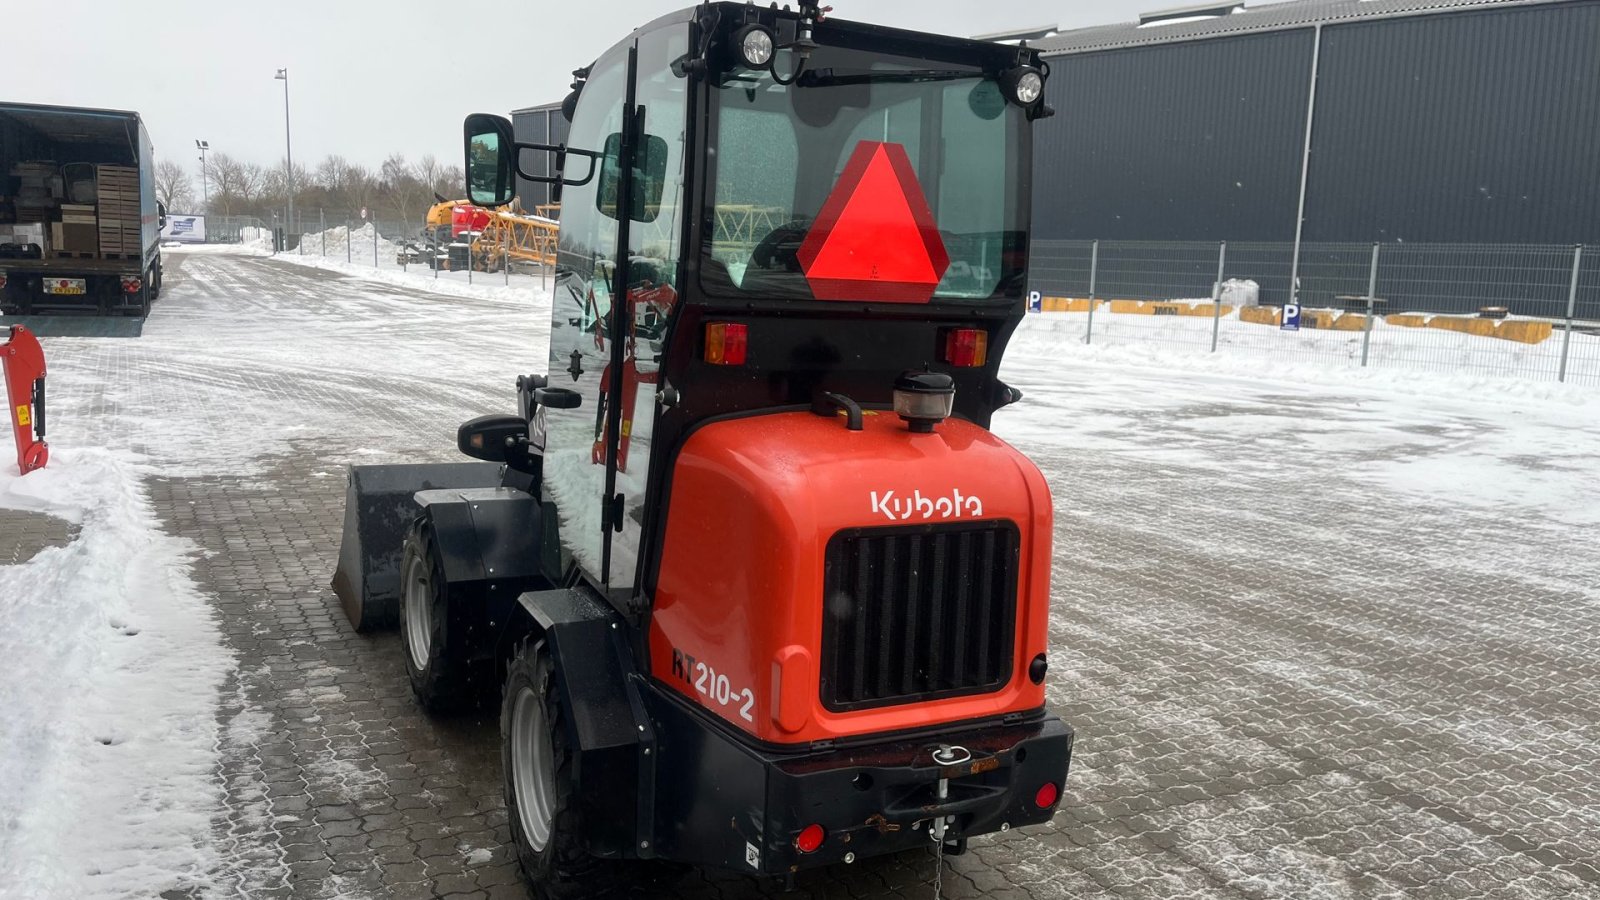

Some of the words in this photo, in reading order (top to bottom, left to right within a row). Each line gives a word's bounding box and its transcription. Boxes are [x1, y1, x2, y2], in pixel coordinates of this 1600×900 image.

[1030, 291, 1041, 307] P
[1283, 304, 1299, 324] P
[870, 488, 983, 520] Kubota
[672, 647, 754, 722] RT210-2
